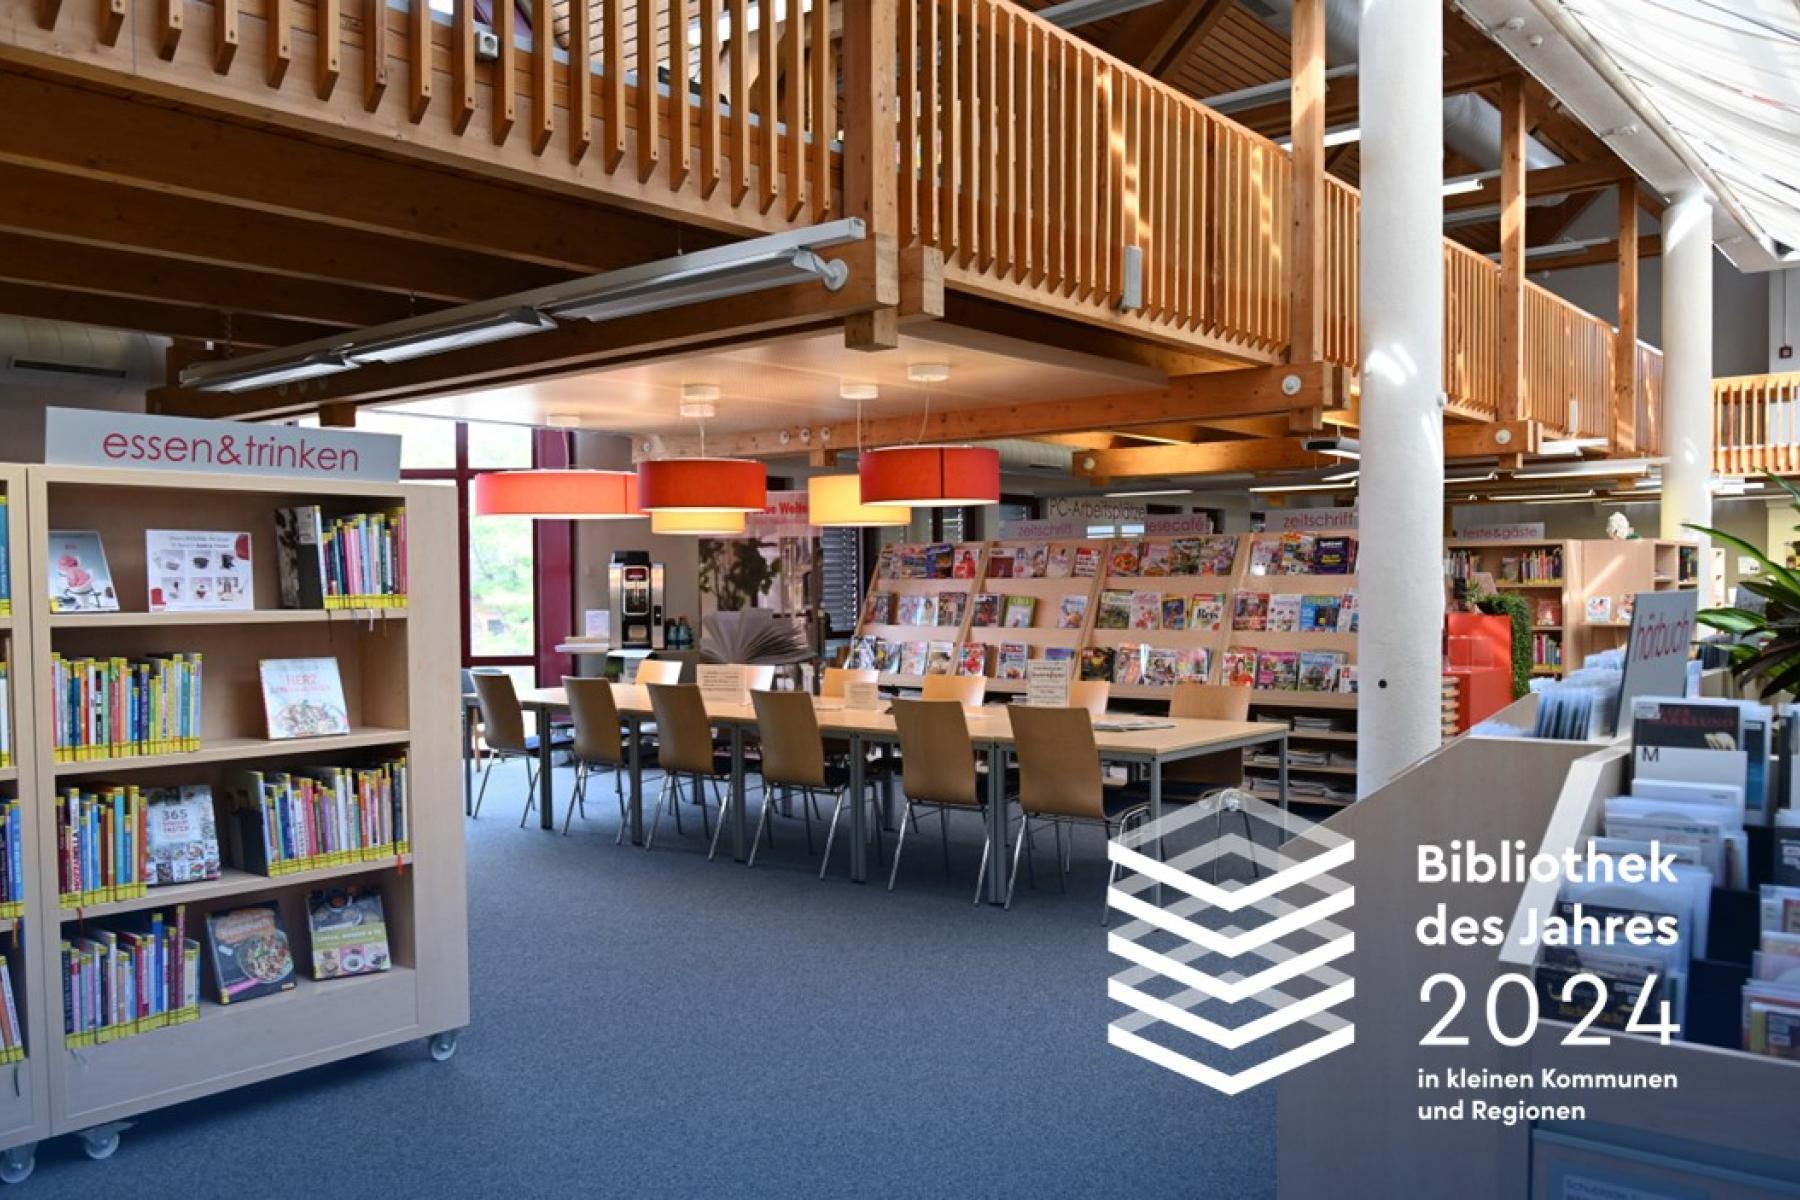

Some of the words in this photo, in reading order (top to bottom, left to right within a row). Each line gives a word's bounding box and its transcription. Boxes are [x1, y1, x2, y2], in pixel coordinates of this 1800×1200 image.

[102, 432, 360, 471] essen&trinken
[1283, 511, 1353, 529] zeitschrift
[1017, 522, 1073, 538] zeitschrift
[1642, 747, 1660, 763] M
